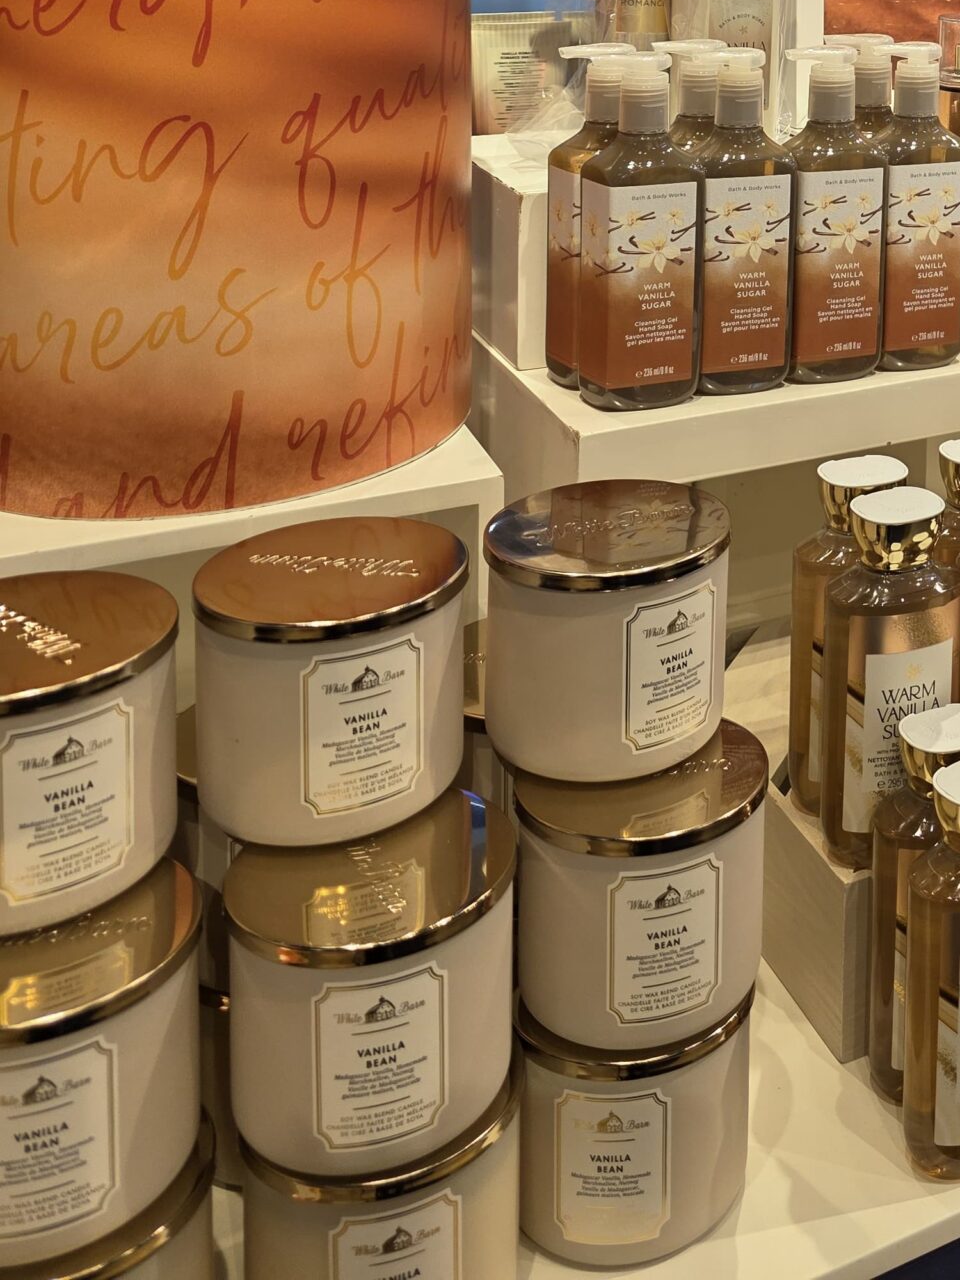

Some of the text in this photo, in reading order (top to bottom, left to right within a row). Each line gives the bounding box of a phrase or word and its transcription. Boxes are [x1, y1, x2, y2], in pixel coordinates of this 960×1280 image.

[920, 253, 943, 261] WARM
[835, 262, 860, 270] WARM
[915, 262, 947, 270] VANILLA
[304, 182, 392, 370] of
[739, 271, 766, 279] WARM
[830, 271, 864, 279] VANILLA
[918, 271, 943, 279] SUGAR
[643, 282, 671, 290] WARM
[734, 280, 770, 289] VANILLA
[833, 280, 860, 288] SUGAR
[638, 291, 676, 301] VANILLA
[737, 289, 766, 298] SUGAR
[641, 301, 672, 310] SUGAR
[634, 318, 666, 327] Cleansing
[639, 323, 673, 332] Hand Soap
[660, 647, 693, 667] VANILLA
[666, 660, 688, 675] BEAN
[882, 680, 936, 705] WARM
[344, 708, 388, 726] VANILLA
[352, 721, 381, 735] BEAN
[44, 780, 94, 803] VANILLA
[53, 795, 86, 813] BEAN
[647, 925, 688, 941] VANILLA
[654, 938, 681, 950] BEAN
[356, 1040, 406, 1058] VANILLA
[366, 1055, 397, 1070] BEAN
[13, 1121, 69, 1143] VANILLA
[24, 1137, 60, 1154] BEAN
[589, 1154, 631, 1163] VANILLA
[597, 1165, 624, 1173] BEAN
